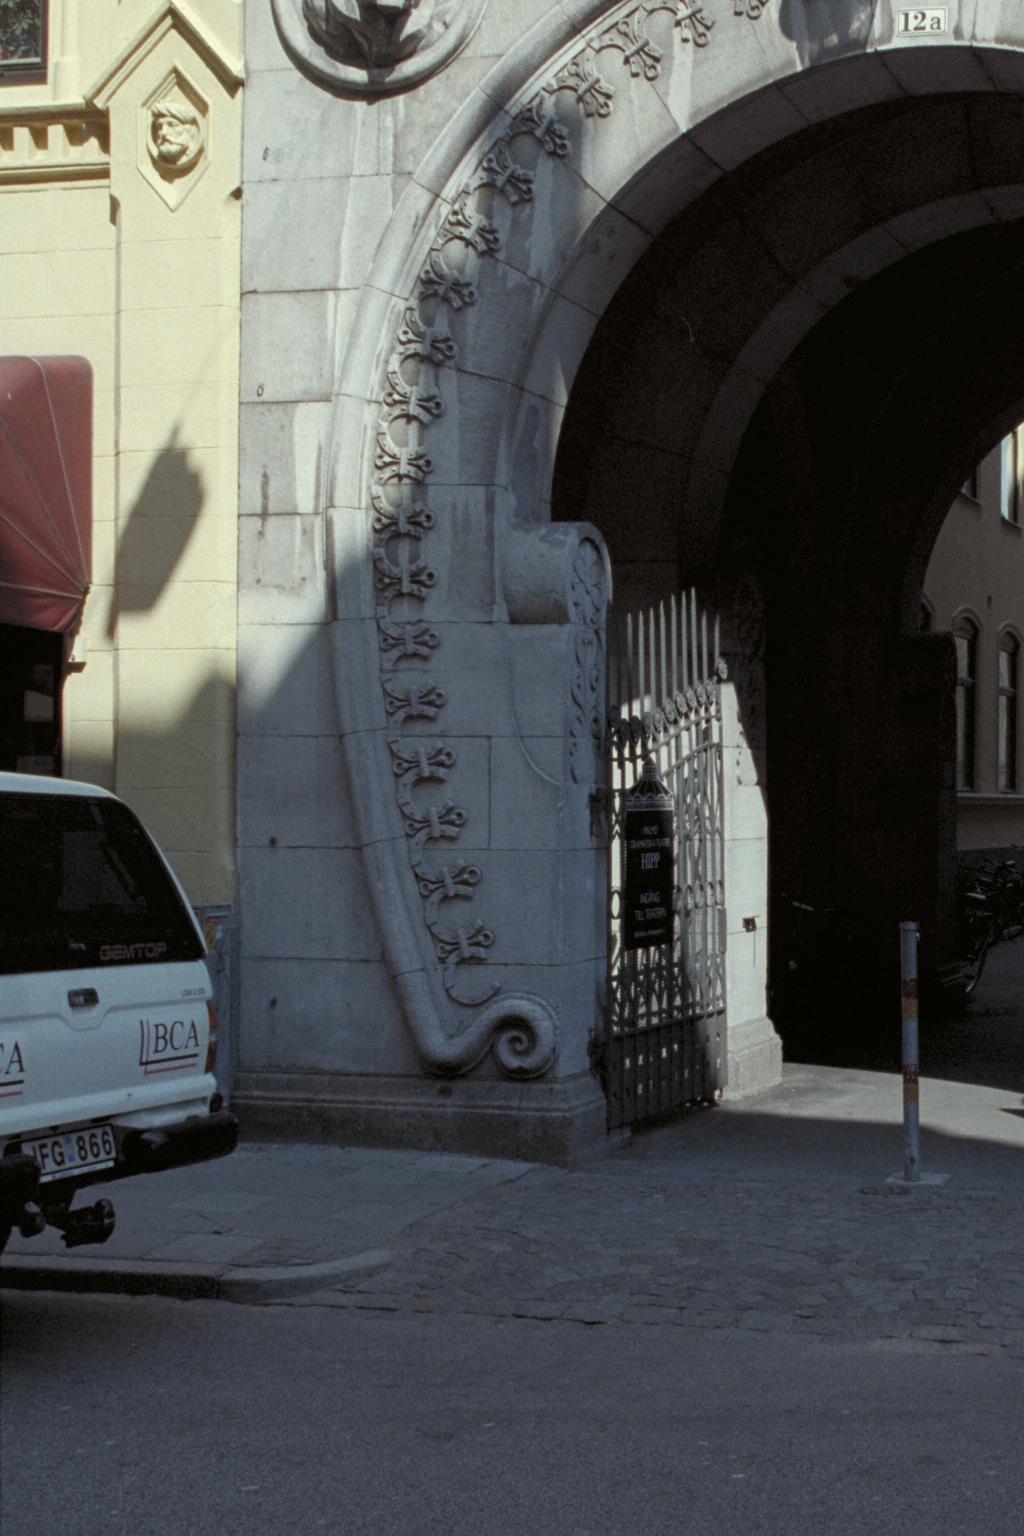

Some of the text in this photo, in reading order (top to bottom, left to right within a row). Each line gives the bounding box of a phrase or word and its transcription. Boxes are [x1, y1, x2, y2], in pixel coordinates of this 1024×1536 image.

[901, 11, 942, 32] 12a
[100, 942, 167, 961] GEMTOP
[153, 1019, 200, 1054] BCA
[76, 1129, 113, 1162] 866
